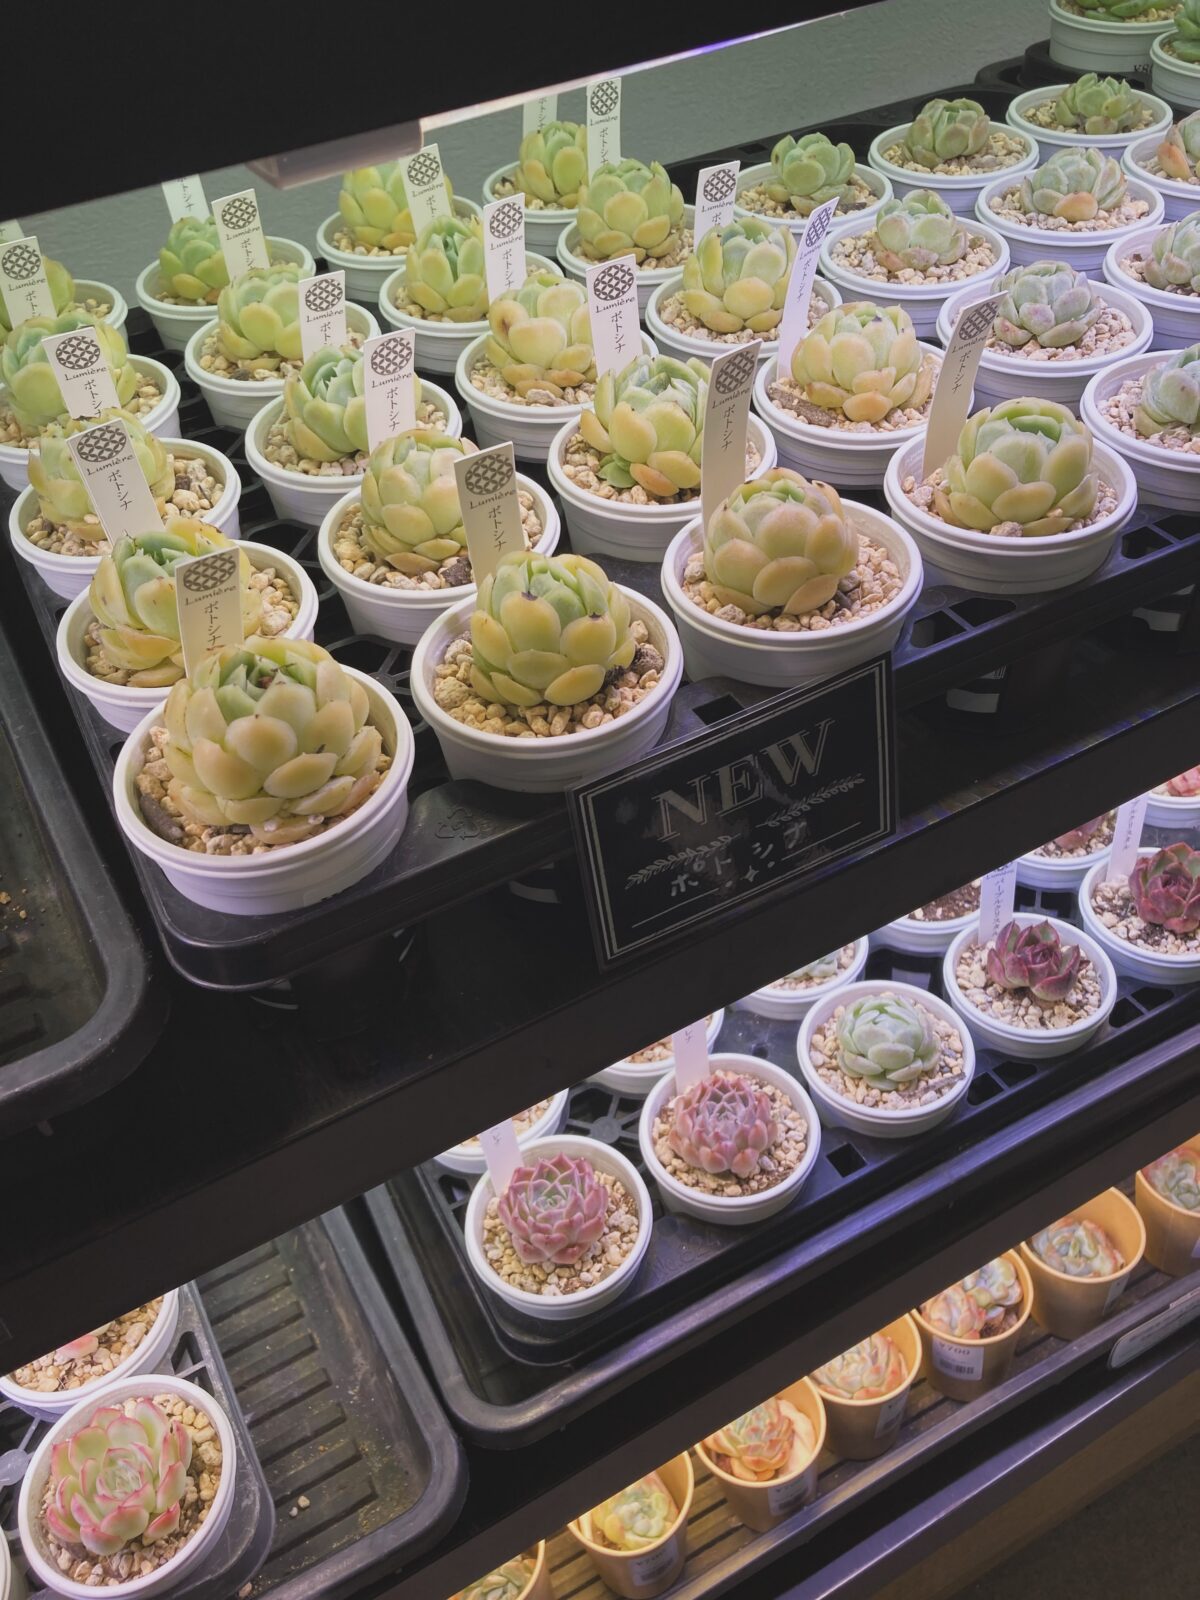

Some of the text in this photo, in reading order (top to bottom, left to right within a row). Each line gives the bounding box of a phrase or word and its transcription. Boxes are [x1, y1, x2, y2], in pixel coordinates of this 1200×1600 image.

[596, 296, 636, 314] Lumière
[64, 366, 109, 381] Lumière
[371, 372, 413, 389] Lumière
[86, 454, 134, 476] Lumière
[470, 489, 517, 510] Lumière
[185, 585, 237, 607] Lumière
[651, 718, 836, 842] NEW
